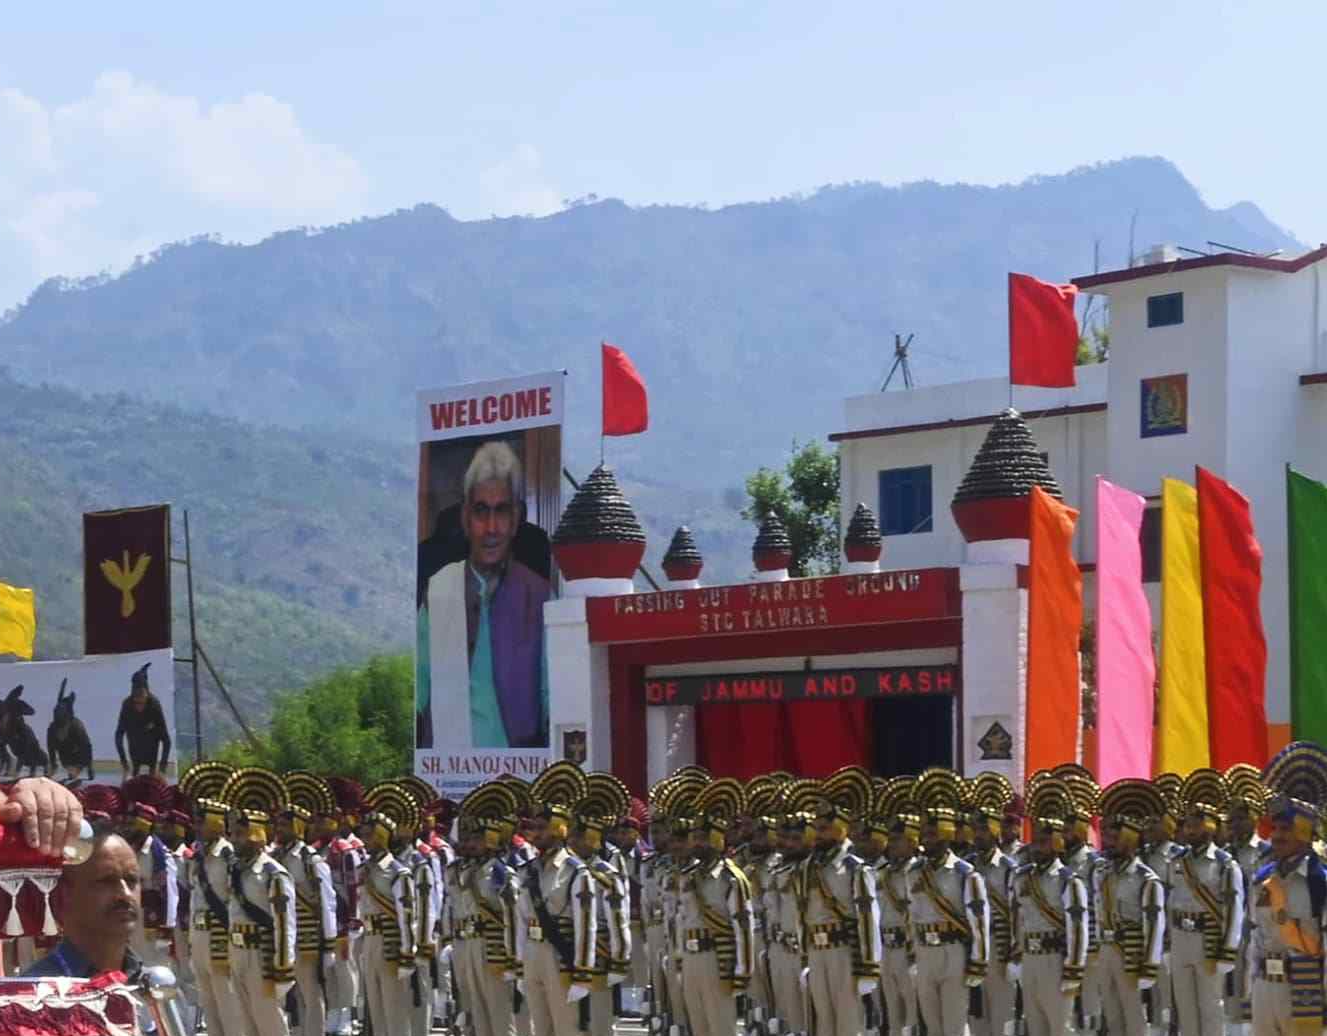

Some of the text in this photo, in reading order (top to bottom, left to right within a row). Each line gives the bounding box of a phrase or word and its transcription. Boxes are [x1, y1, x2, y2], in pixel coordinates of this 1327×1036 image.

[429, 386, 552, 431] WELCOME
[750, 579, 825, 603] PARADE
[648, 670, 953, 704] OF JAMMU AND KASH
[447, 755, 500, 775] MANOJ
